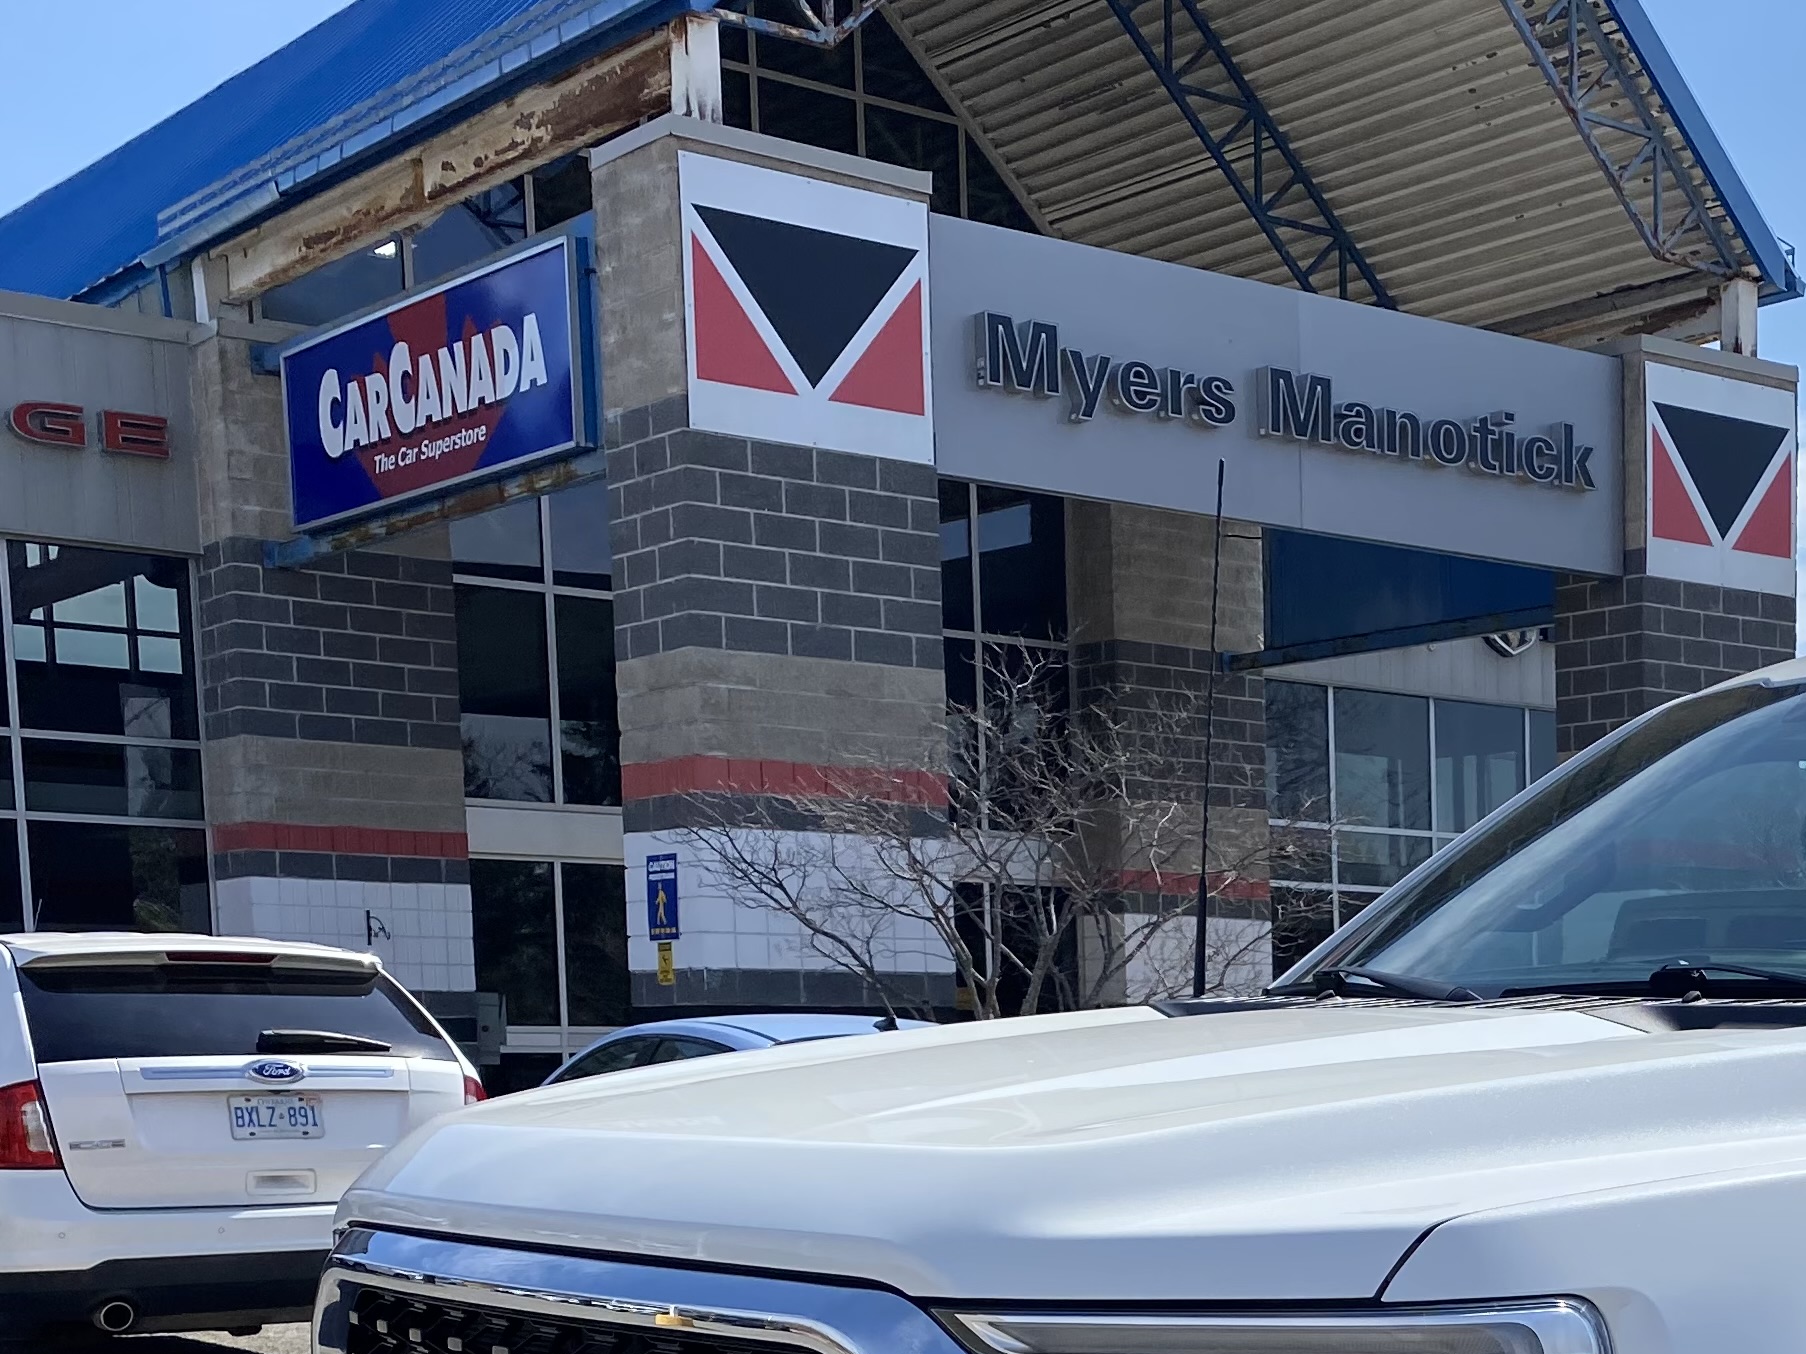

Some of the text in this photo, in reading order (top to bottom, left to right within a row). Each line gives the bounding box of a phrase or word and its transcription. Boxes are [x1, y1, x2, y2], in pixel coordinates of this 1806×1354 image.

[976, 309, 1598, 491] Myers Manotick
[374, 424, 487, 474] The Car Superstore
[234, 1106, 318, 1127] BXLZ 891
